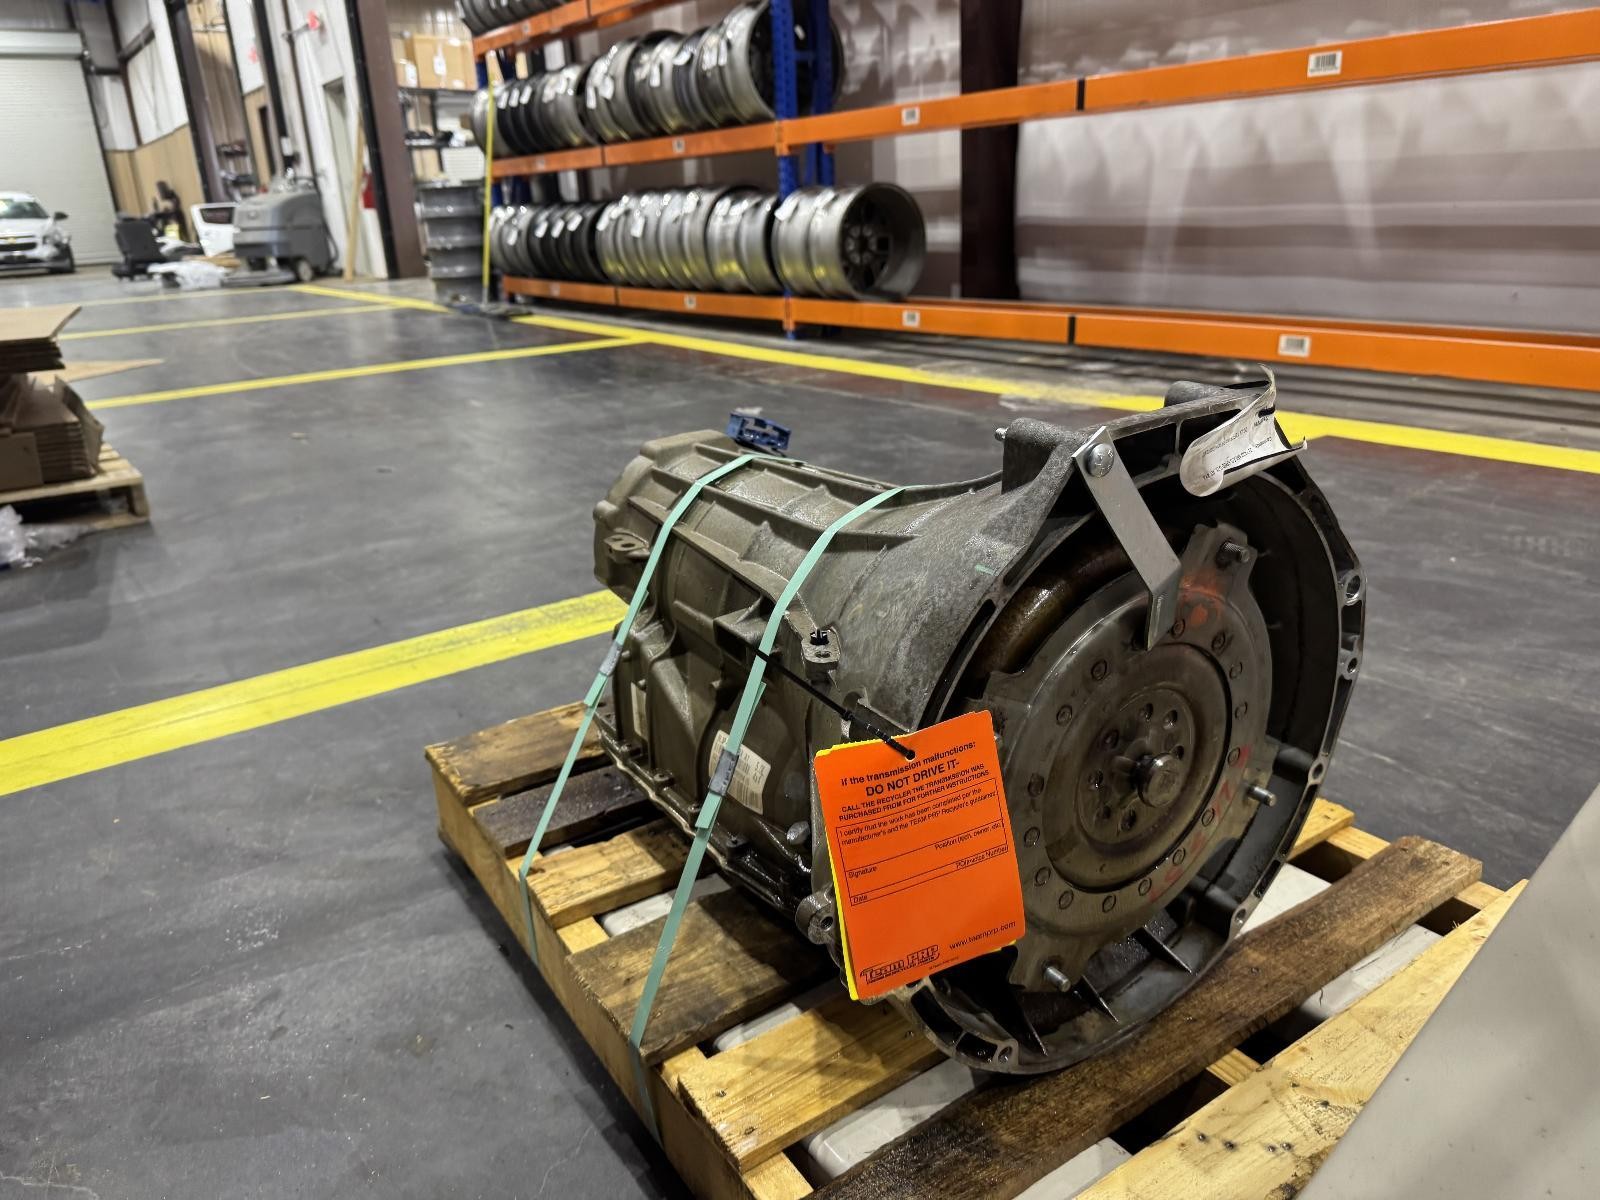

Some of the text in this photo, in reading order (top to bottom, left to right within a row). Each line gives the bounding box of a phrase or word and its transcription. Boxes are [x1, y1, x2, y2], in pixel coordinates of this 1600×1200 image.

[841, 741, 976, 786] If the transmission malfunctions:
[866, 759, 960, 796] DO NOT DRIVE IT-
[839, 808, 882, 821] PURCHASED
[883, 801, 902, 812] FROM
[903, 796, 917, 806] FOR
[917, 786, 946, 800] FURTHER
[841, 763, 985, 812] CALL THE RECYCLER THE TRANSMISSION WAS
[888, 816, 904, 826] work
[904, 811, 916, 819] has
[917, 806, 931, 815] been
[909, 815, 927, 826] TEAM
[949, 920, 1016, 950] www.teamprp.com
